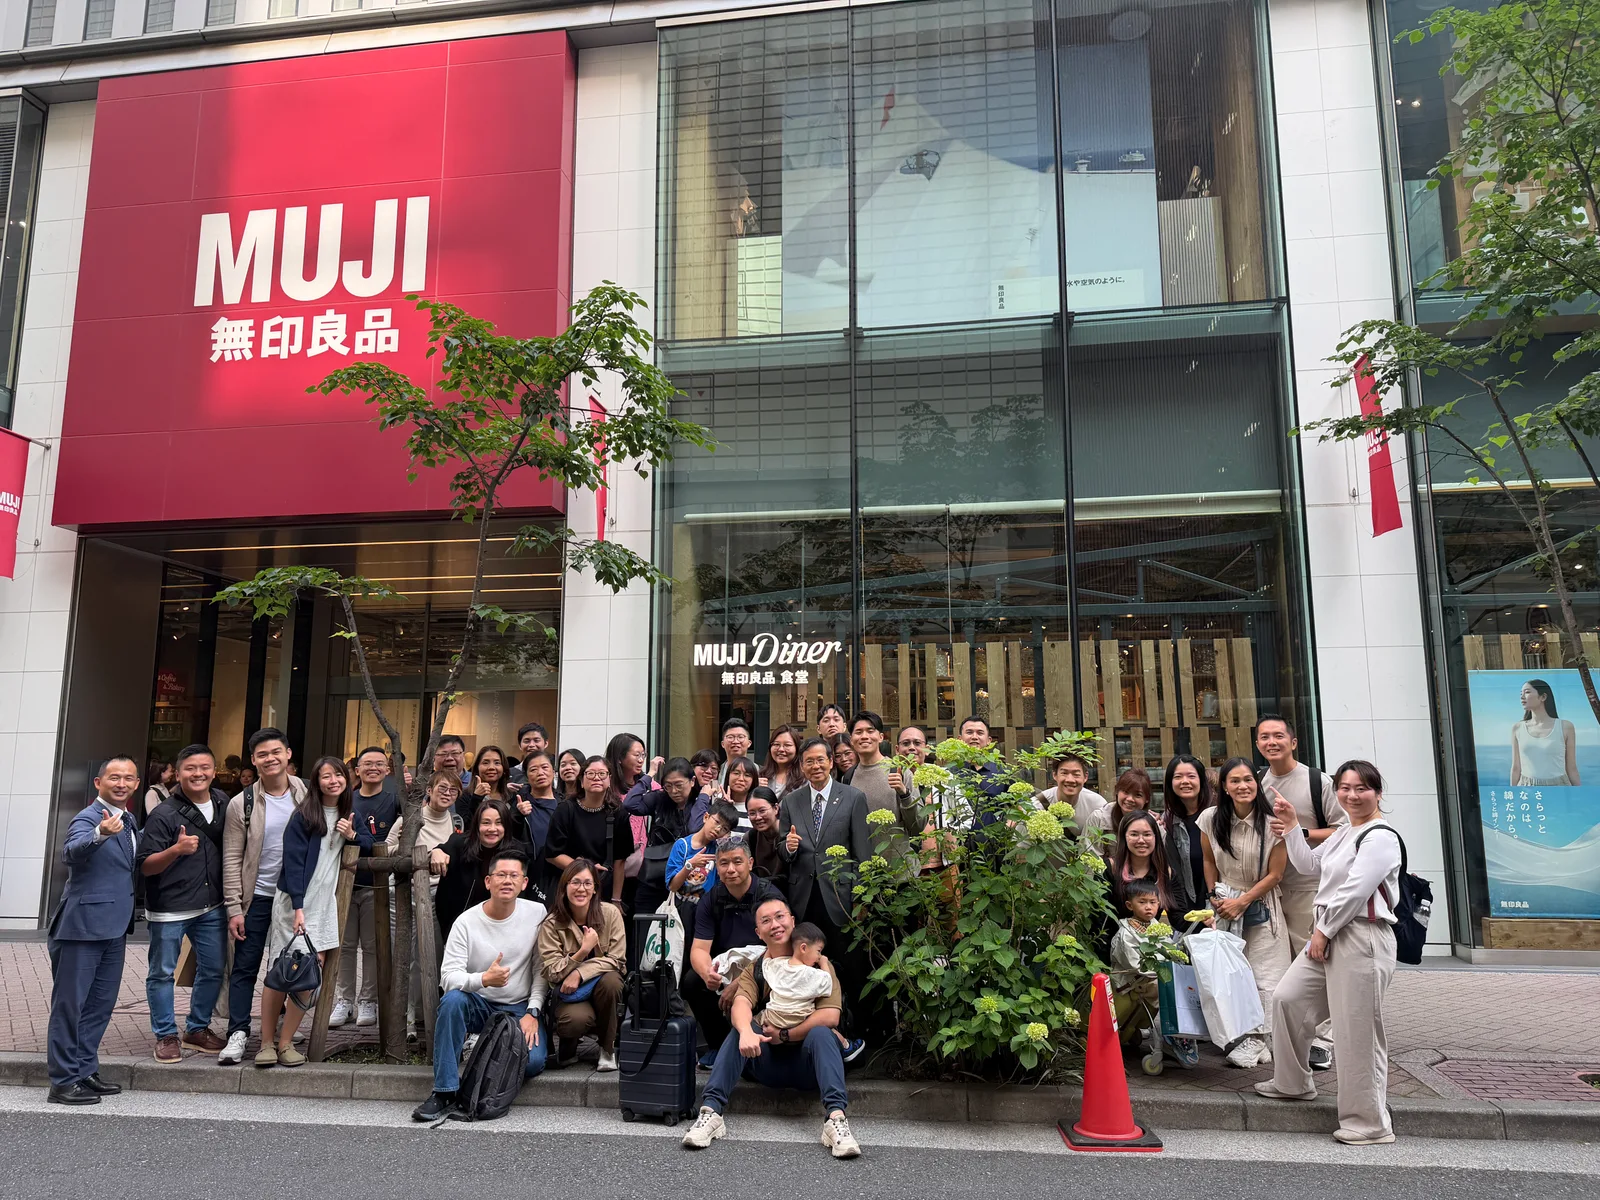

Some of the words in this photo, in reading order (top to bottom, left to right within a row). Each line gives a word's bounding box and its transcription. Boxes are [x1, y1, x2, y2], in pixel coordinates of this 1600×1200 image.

[193, 196, 430, 307] MUJI
[209, 308, 400, 363] 無印良品
[693, 643, 746, 667] MUJI
[747, 632, 842, 667] Diner
[721, 671, 776, 685] 無印良品
[780, 669, 809, 685] 食堂
[1504, 790, 1518, 839] 綿だから。
[1519, 790, 1532, 829] なのは、
[1535, 790, 1546, 834] さらっと
[1500, 900, 1529, 909] 無印良品
